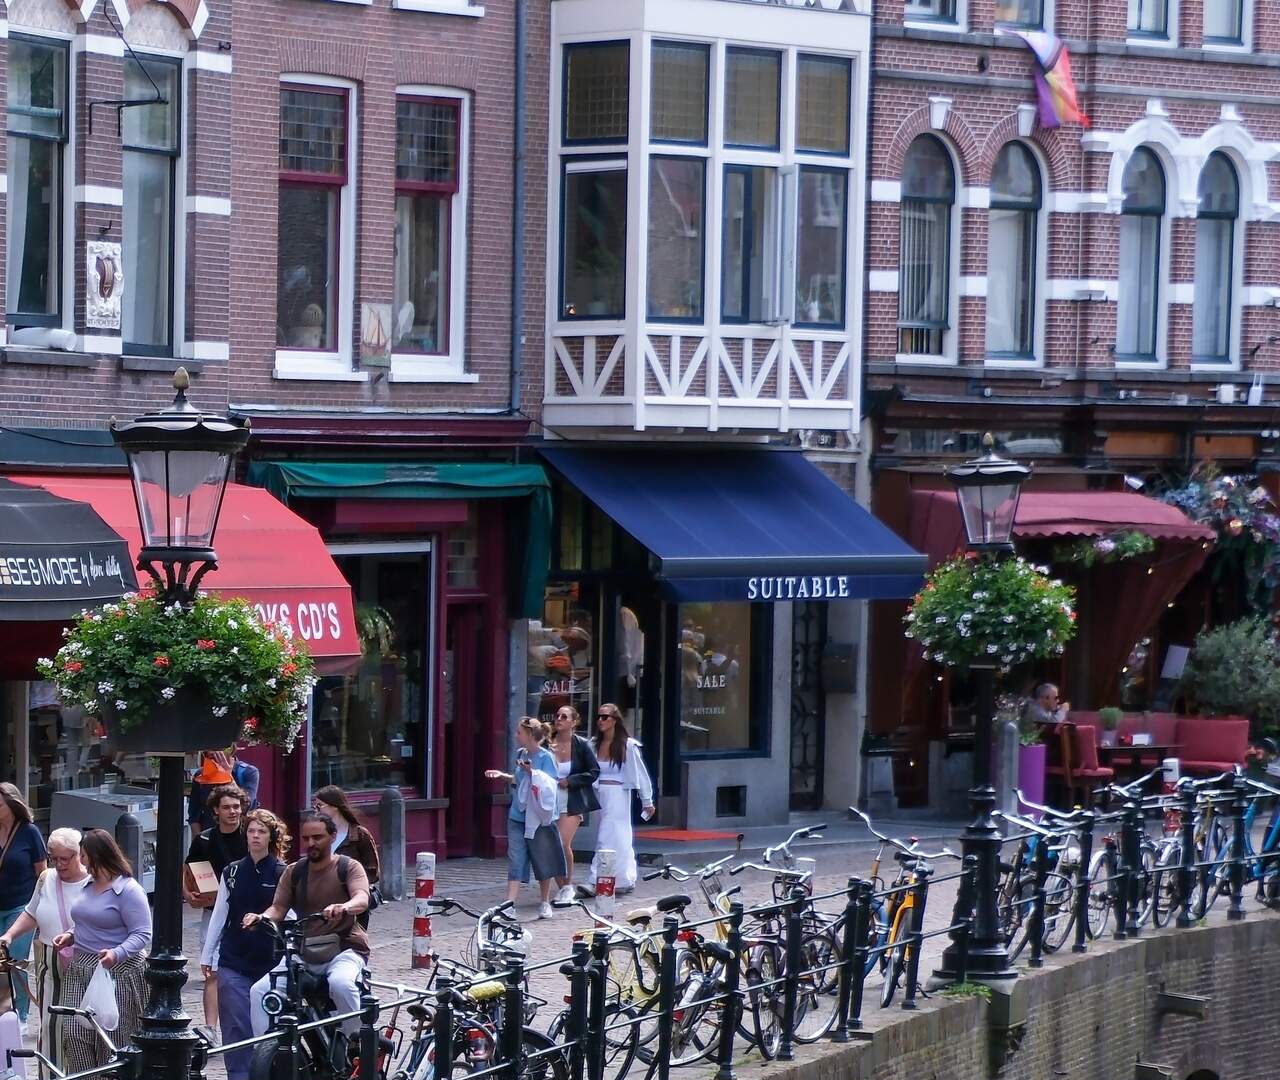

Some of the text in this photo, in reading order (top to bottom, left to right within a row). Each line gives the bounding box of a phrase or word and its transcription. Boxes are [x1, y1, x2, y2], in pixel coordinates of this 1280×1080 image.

[747, 576, 849, 600] SUITABLE
[297, 602, 341, 641] CD'S
[542, 678, 576, 695] SALE
[696, 674, 727, 689] SALE
